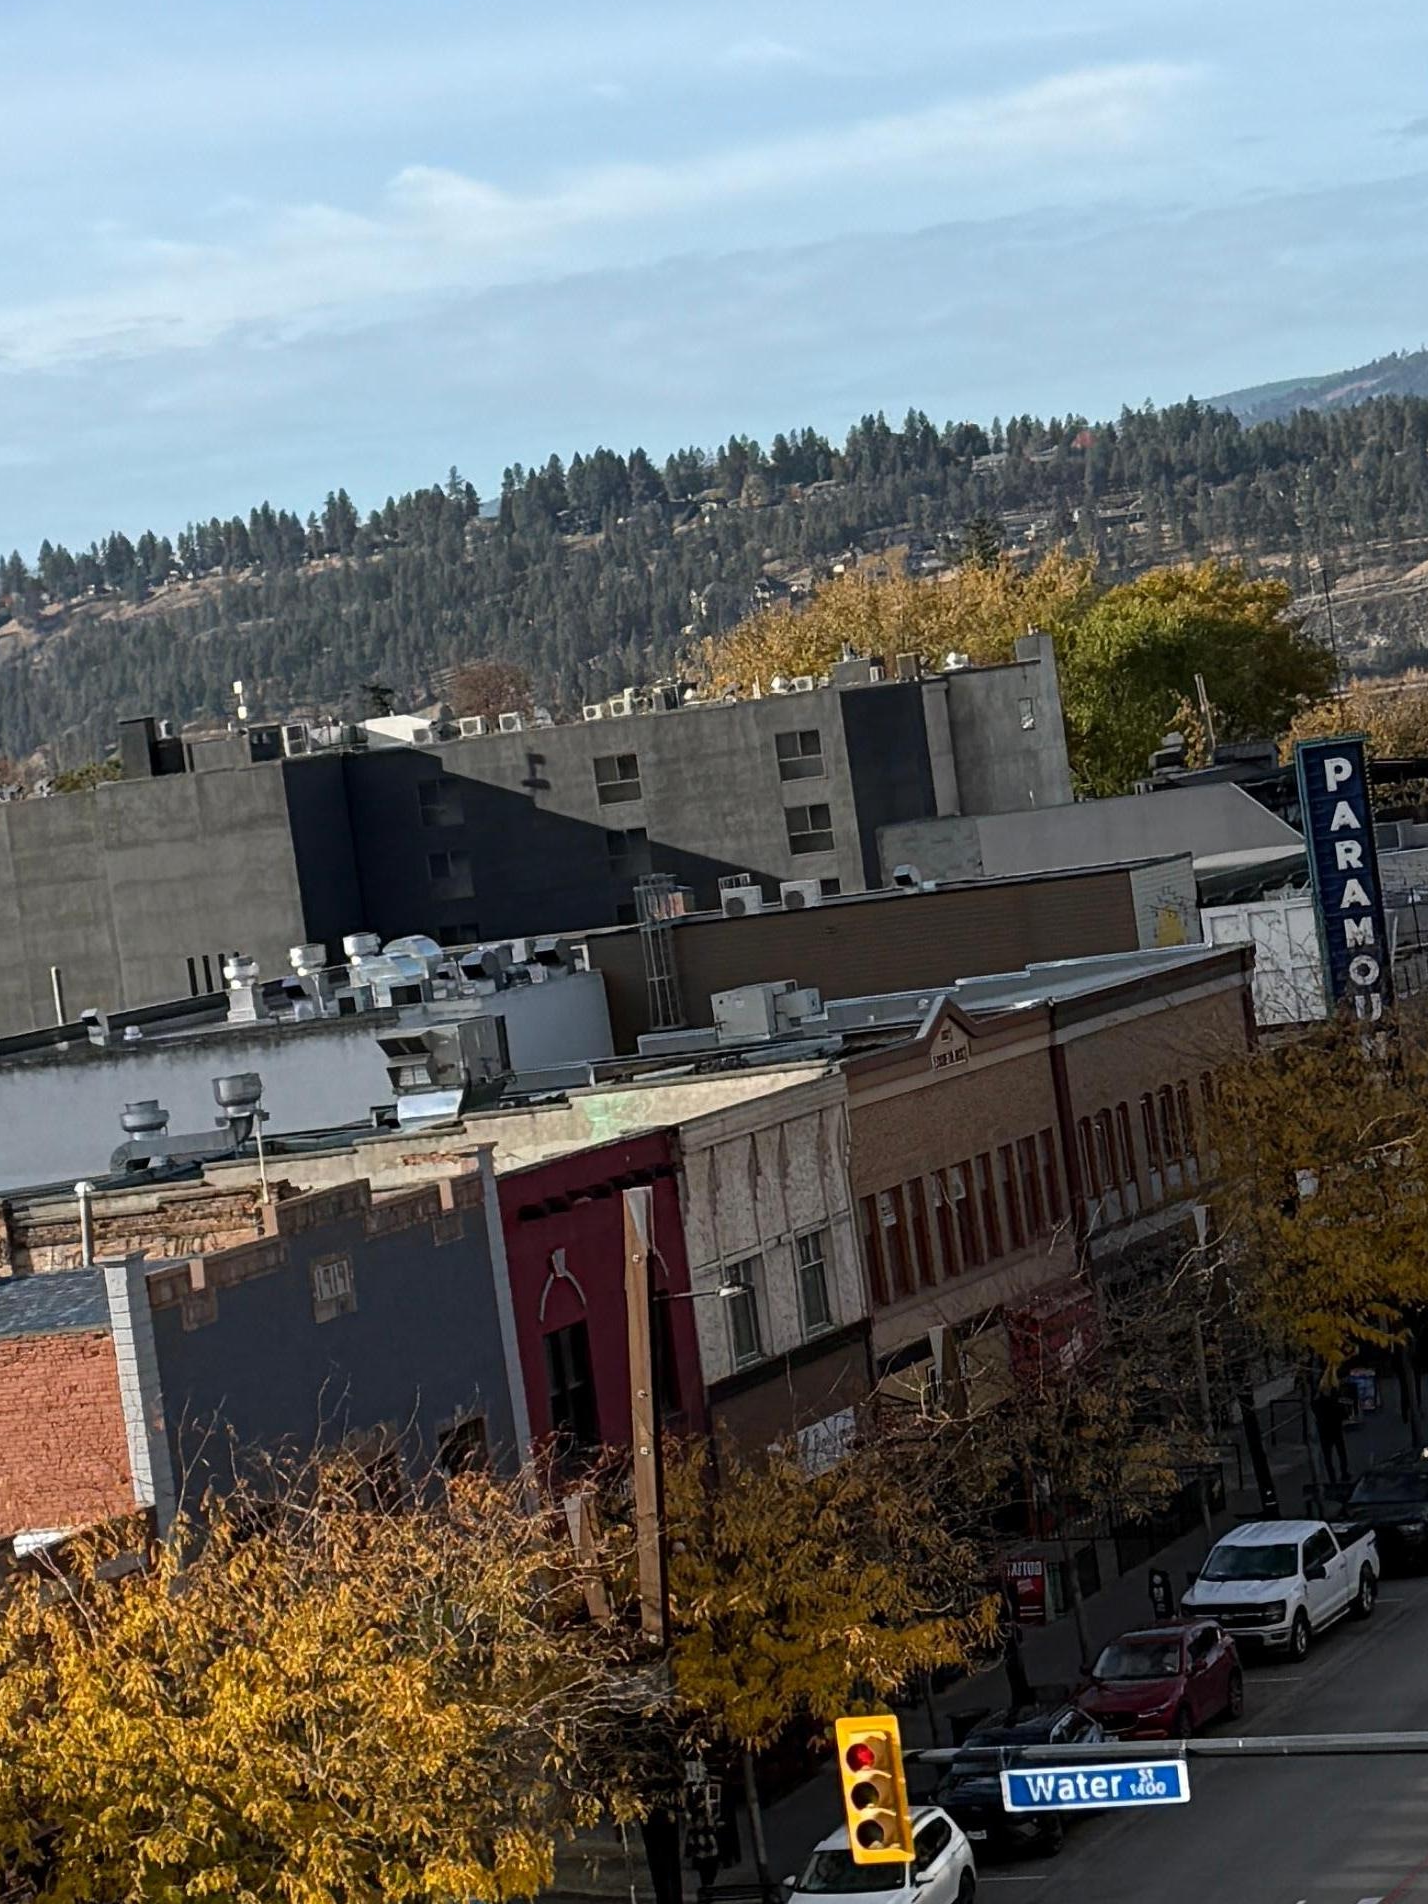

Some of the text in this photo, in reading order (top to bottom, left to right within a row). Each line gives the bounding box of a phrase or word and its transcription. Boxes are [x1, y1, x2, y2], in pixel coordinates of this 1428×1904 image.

[1138, 1768, 1154, 1783] St
[1026, 1773, 1122, 1802] Water
[1129, 1781, 1166, 1796] 1400
